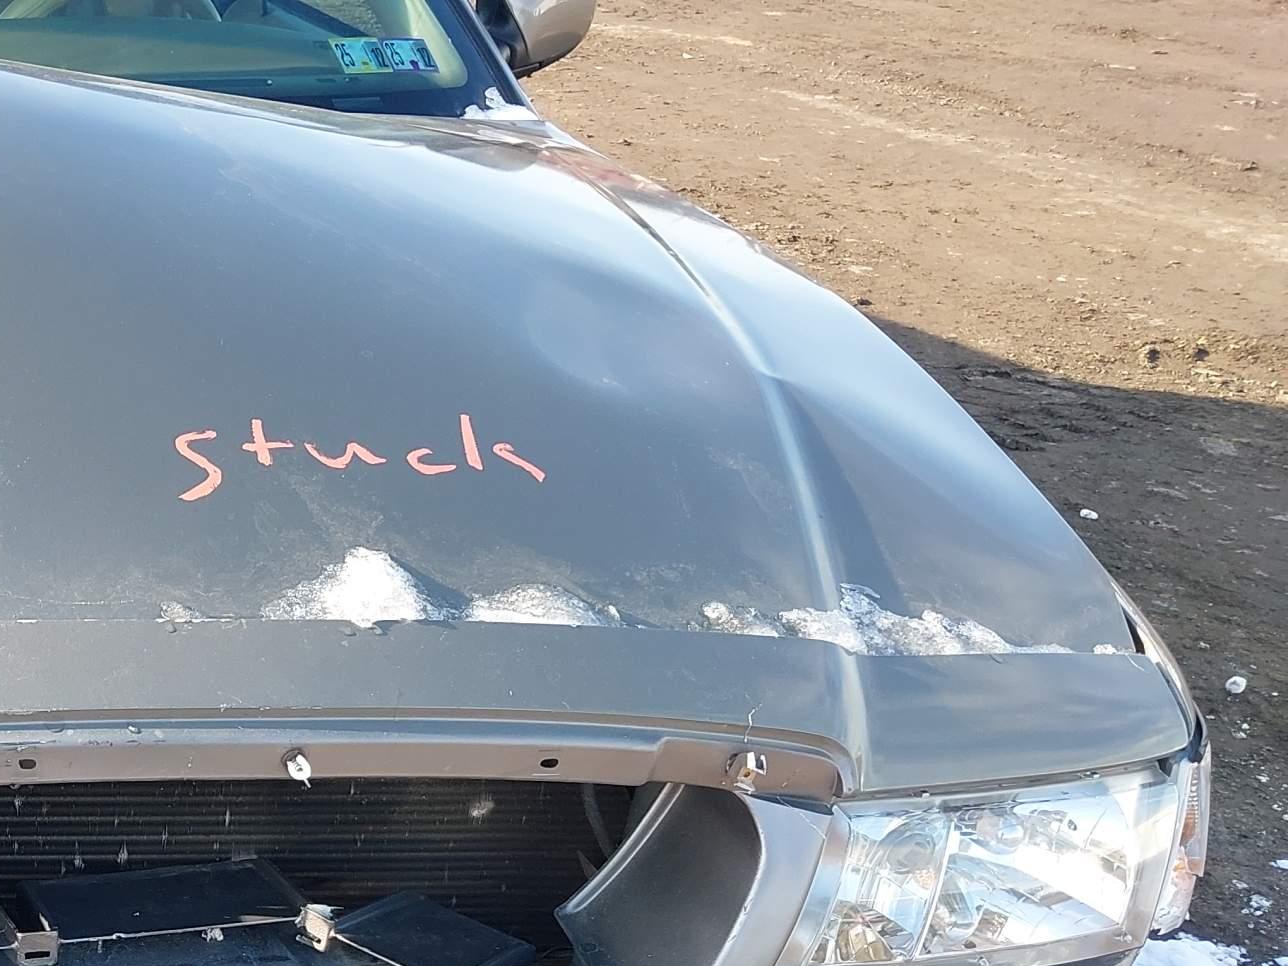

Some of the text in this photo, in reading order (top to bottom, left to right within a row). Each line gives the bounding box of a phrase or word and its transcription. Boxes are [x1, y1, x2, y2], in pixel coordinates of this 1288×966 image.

[334, 43, 389, 68] 25 12
[384, 42, 436, 68] 25 12
